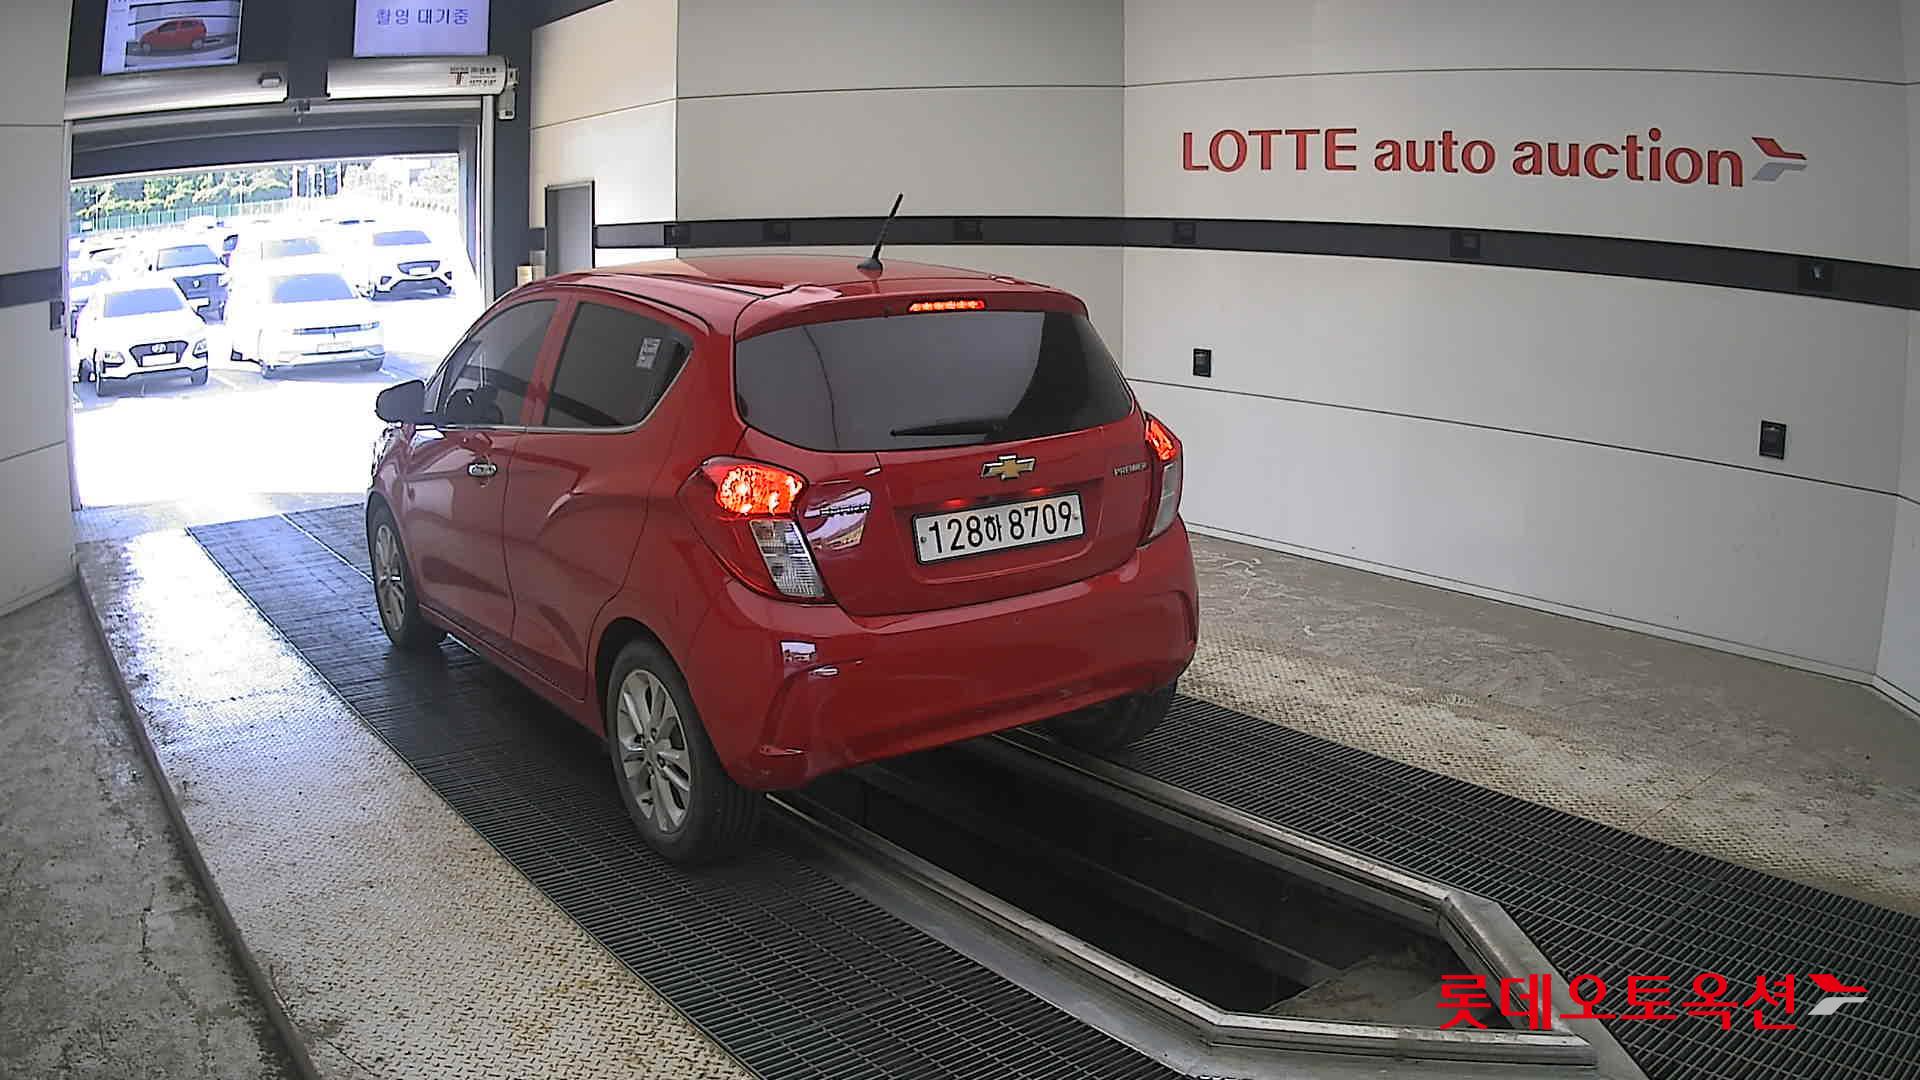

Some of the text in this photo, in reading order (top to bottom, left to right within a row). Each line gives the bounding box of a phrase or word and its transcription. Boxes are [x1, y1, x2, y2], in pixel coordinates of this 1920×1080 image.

[417, 7, 470, 26] 대기중
[1182, 127, 1744, 188] LOTTE auto auction
[928, 500, 1073, 555] 128하 8709
